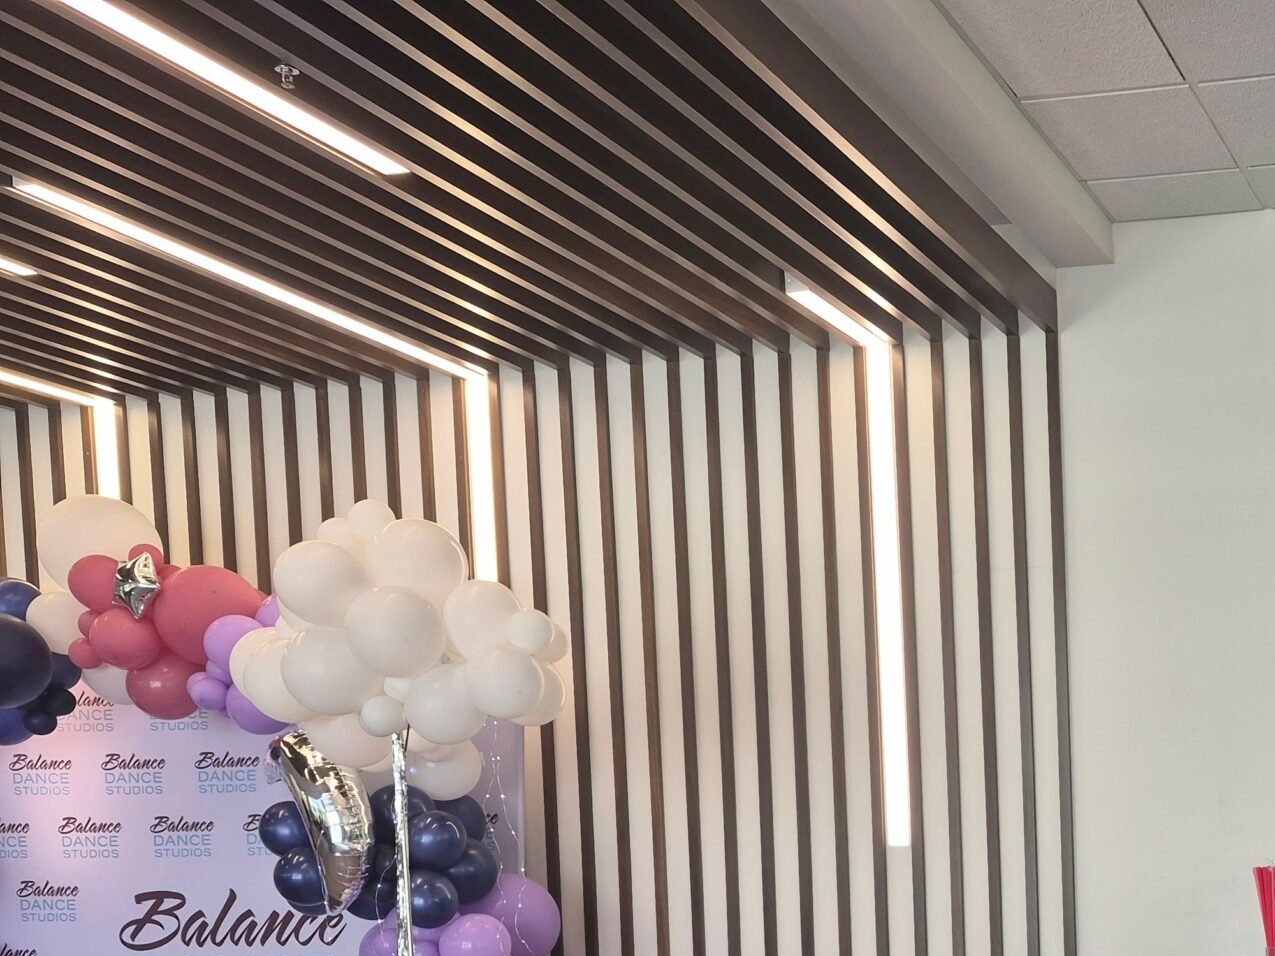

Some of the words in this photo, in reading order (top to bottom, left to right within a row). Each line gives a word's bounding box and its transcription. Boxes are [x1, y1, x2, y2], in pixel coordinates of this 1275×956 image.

[58, 709, 114, 721] ANCE
[57, 722, 114, 732] STUDIOS
[150, 721, 209, 731] STUDIOS
[9, 754, 72, 771] Balance
[101, 754, 166, 771] Balance
[194, 751, 260, 770] Balance
[12, 772, 70, 785] DANCE
[104, 771, 163, 784] DANCE
[198, 770, 257, 782] DANCE
[13, 786, 70, 796] STUDIOS
[105, 785, 163, 795] STUDIOS
[198, 783, 257, 794] STUDIOS
[58, 816, 122, 834] Balance
[150, 815, 215, 834] Balance
[61, 835, 119, 848] DANCE
[153, 834, 212, 847] DANCE
[63, 849, 119, 859] STUDIOS
[154, 848, 212, 858] STUDIOS
[16, 880, 80, 898] Balance
[20, 899, 77, 911] DANCE
[21, 912, 77, 922] STUDIOS
[119, 888, 347, 951] Balance
